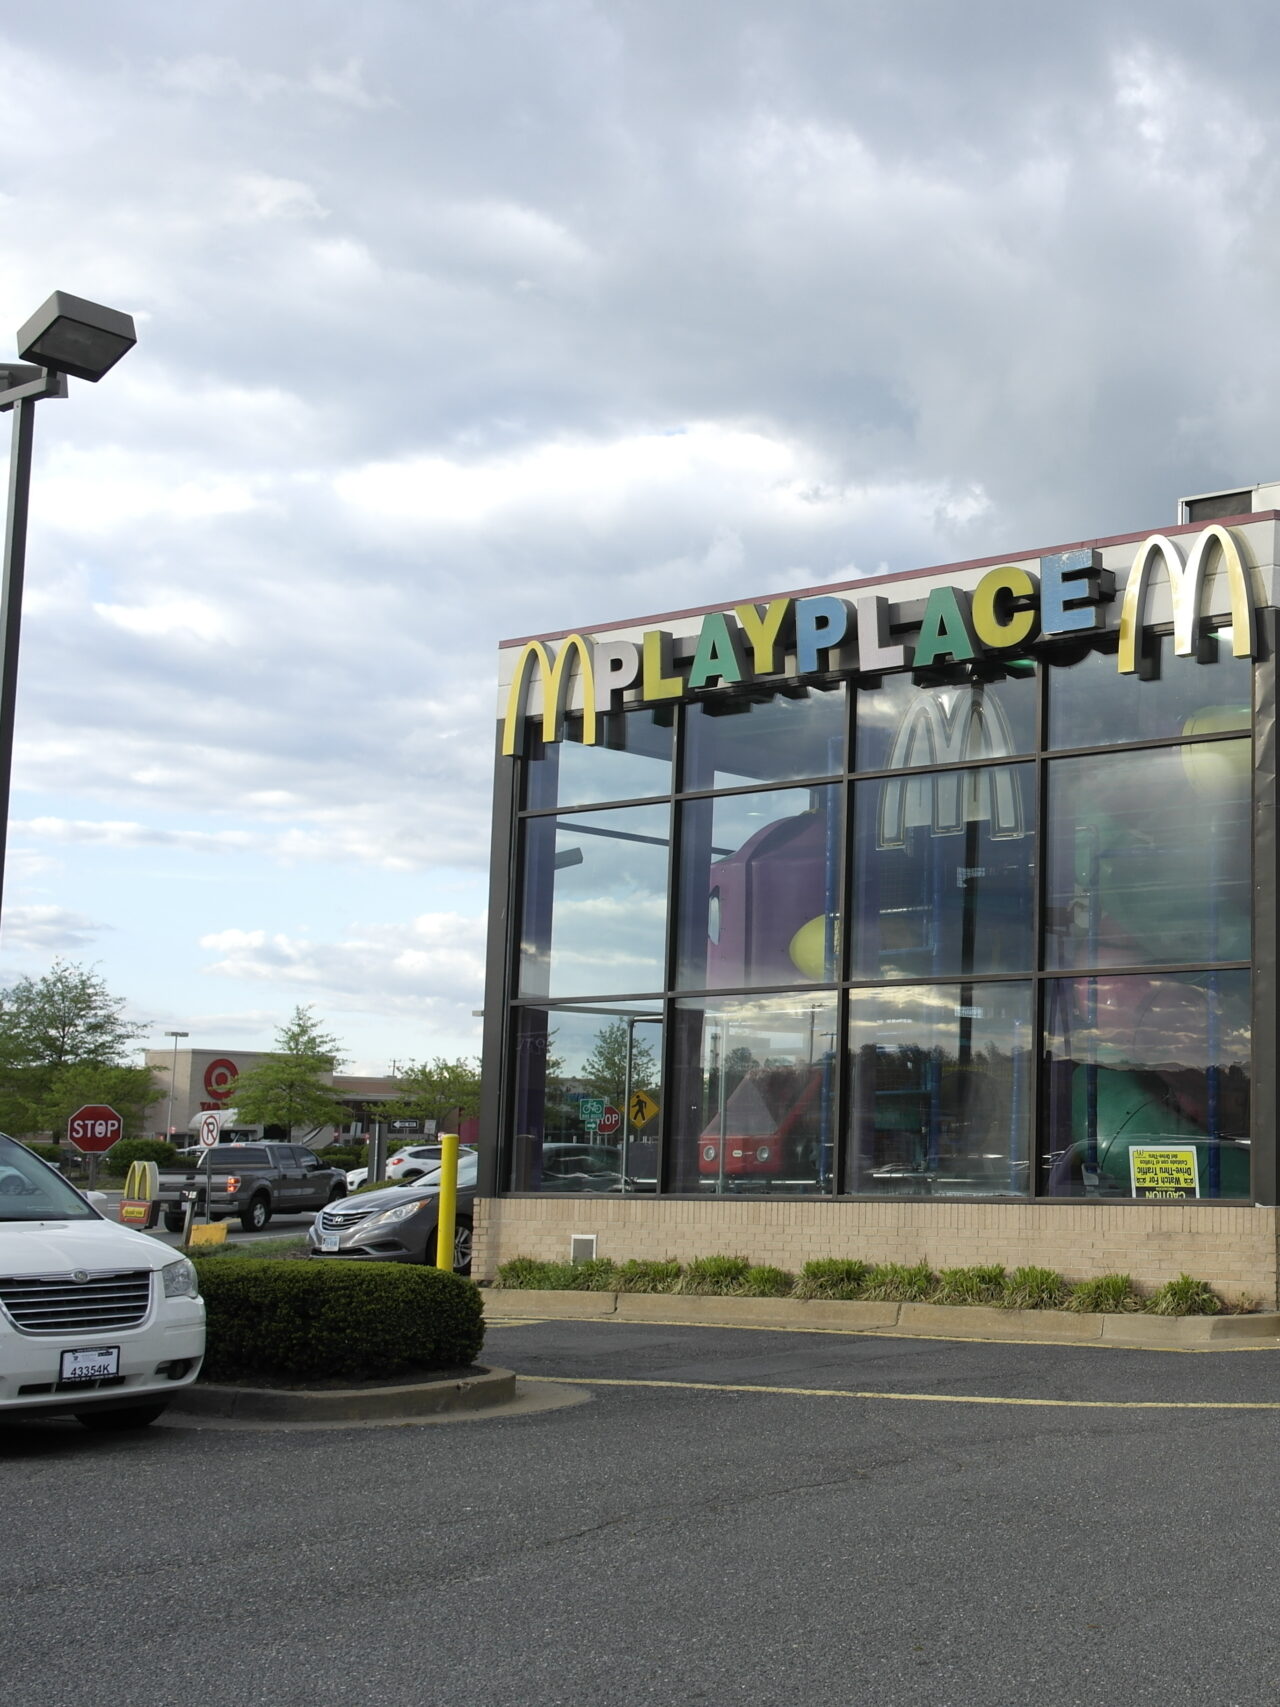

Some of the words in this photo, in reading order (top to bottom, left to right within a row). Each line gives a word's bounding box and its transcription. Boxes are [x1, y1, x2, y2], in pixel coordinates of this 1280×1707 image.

[594, 548, 1105, 713] PLAYPLACE
[72, 1120, 119, 1138] STOP
[1137, 1167, 1157, 1175] Traffic
[1160, 1167, 1191, 1175] Drive-Thru
[1149, 1177, 1159, 1185] For
[1161, 1177, 1182, 1185] Watch
[70, 1364, 110, 1377] 43354K
